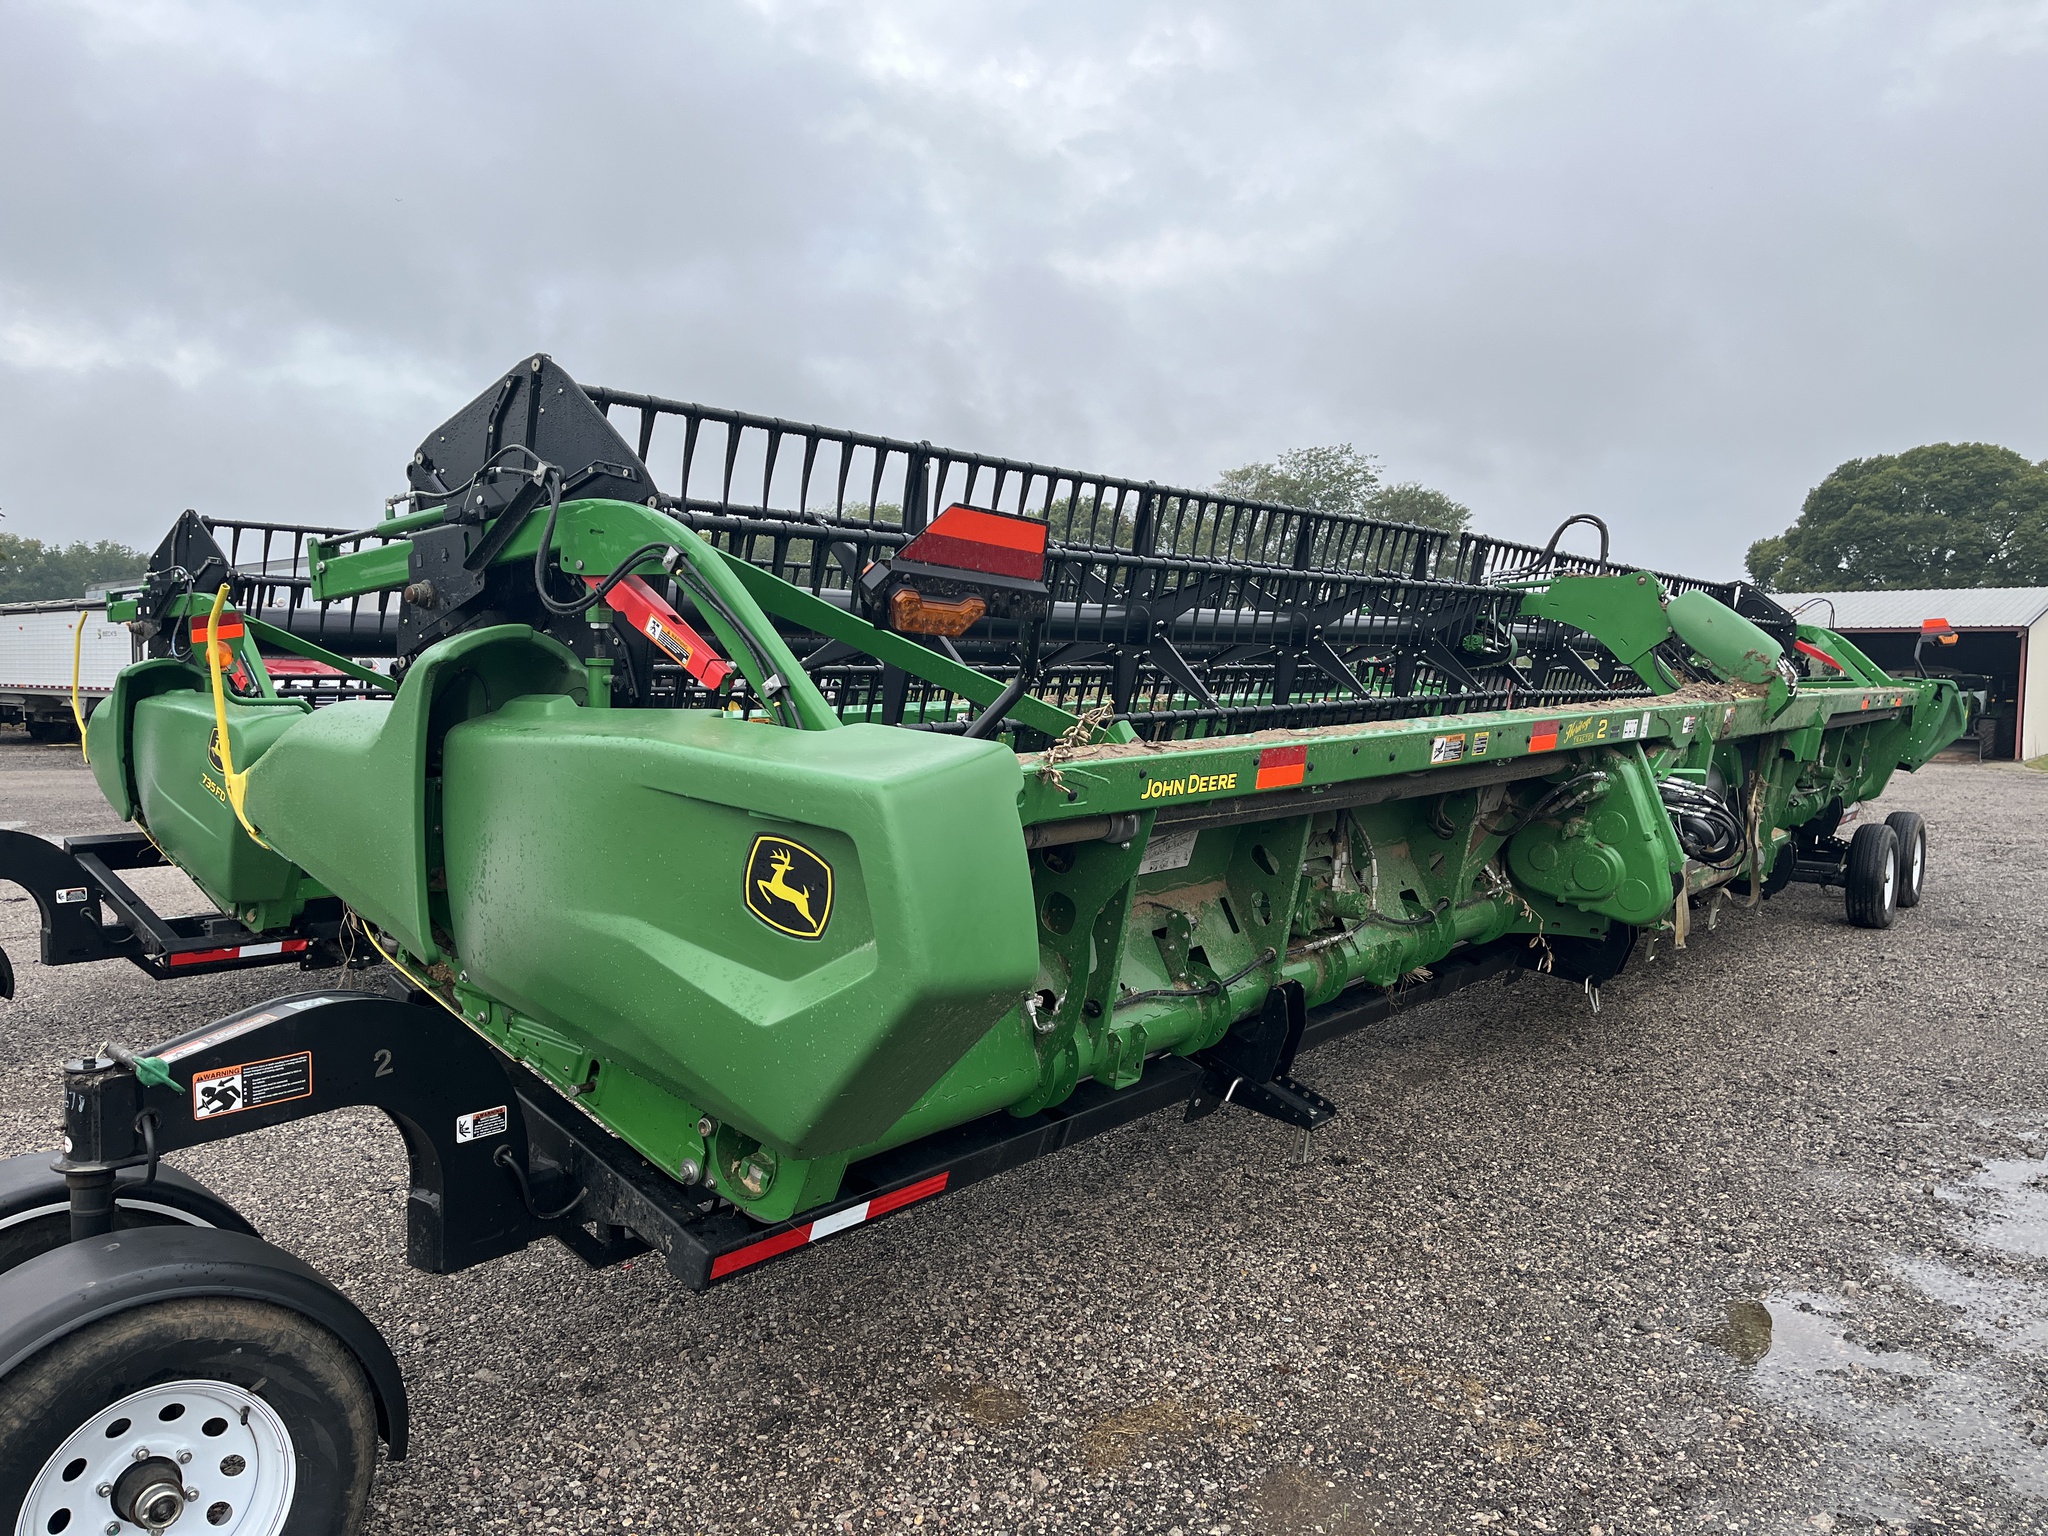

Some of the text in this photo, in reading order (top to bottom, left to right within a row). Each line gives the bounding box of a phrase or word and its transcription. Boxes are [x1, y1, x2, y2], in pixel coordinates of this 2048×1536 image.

[1597, 719, 1608, 739] 2
[1140, 773, 1238, 800] JOHN DEERE
[203, 1068, 240, 1080] WARNING
[373, 1048, 395, 1079] 2
